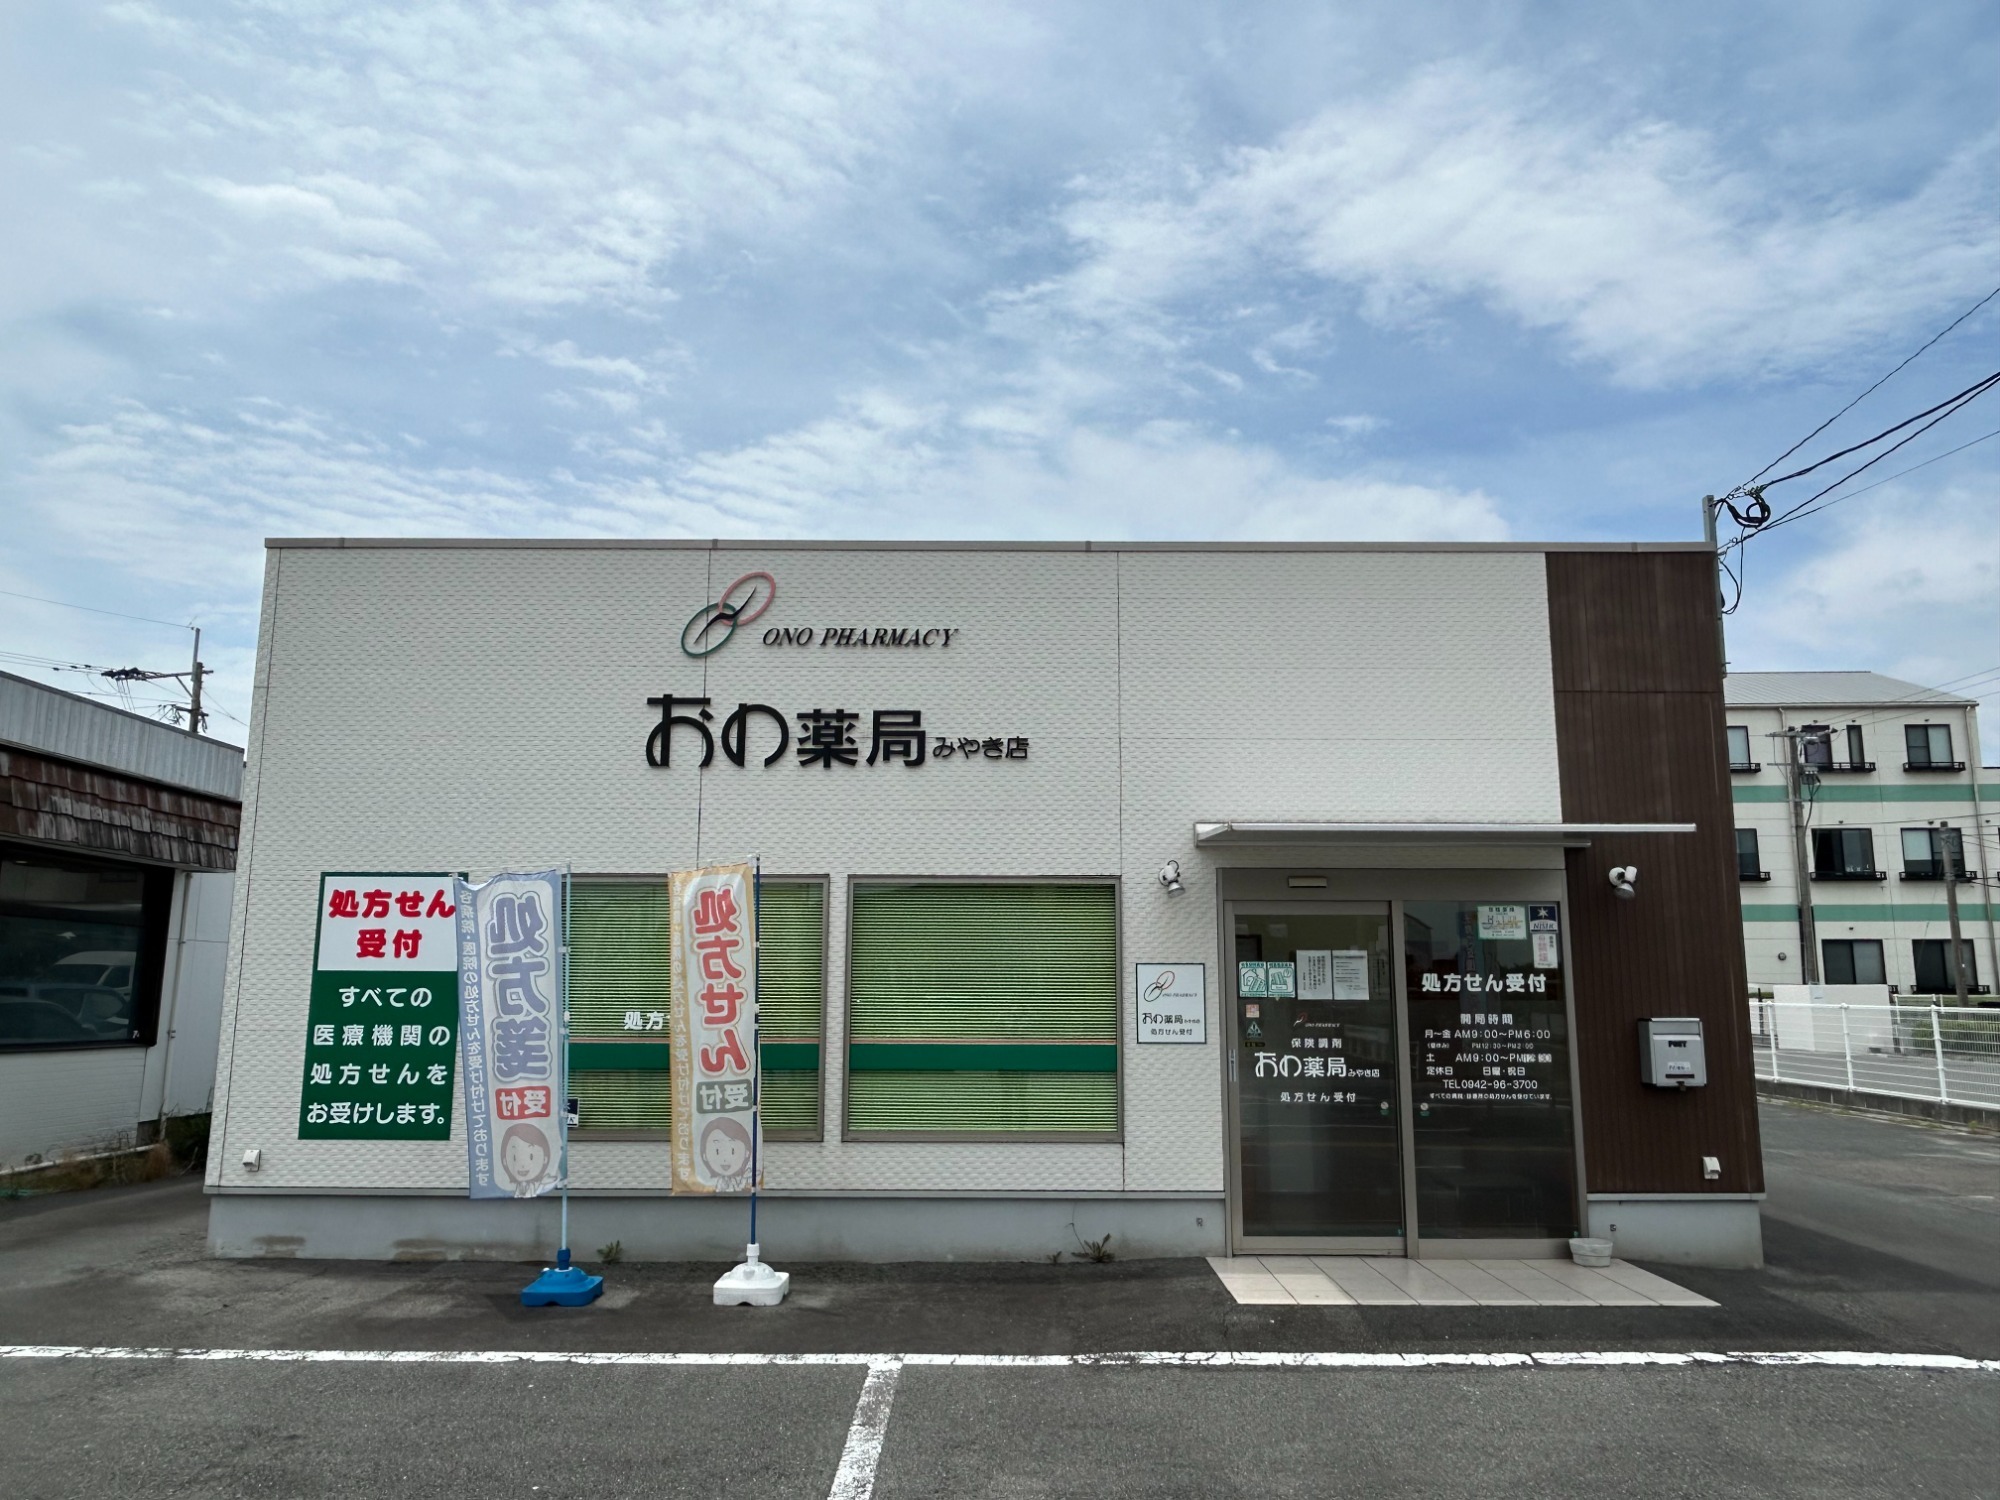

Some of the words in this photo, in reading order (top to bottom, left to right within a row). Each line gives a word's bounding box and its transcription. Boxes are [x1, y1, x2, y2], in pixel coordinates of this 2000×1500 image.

[762, 627, 814, 647] ONO
[818, 627, 959, 648] PHARMACY
[645, 693, 926, 769] おの薬局
[932, 736, 1030, 760] みやき店
[328, 889, 456, 920] 処方せん
[356, 928, 423, 959] 受付
[1421, 972, 1547, 993] 処方せん受付
[338, 986, 432, 1008] すべての
[623, 1011, 670, 1031] 処方
[313, 1023, 450, 1047] 医療機関の
[1291, 1037, 1342, 1049] 保険調剤
[1254, 1051, 1347, 1078] おの薬局
[1426, 1053, 1436, 1063] 土
[310, 1062, 448, 1085] 処方せんを
[1426, 1066, 1454, 1076] 定休日
[1280, 1091, 1356, 1103] 処方せん受付
[306, 1101, 446, 1125] お受けします。
